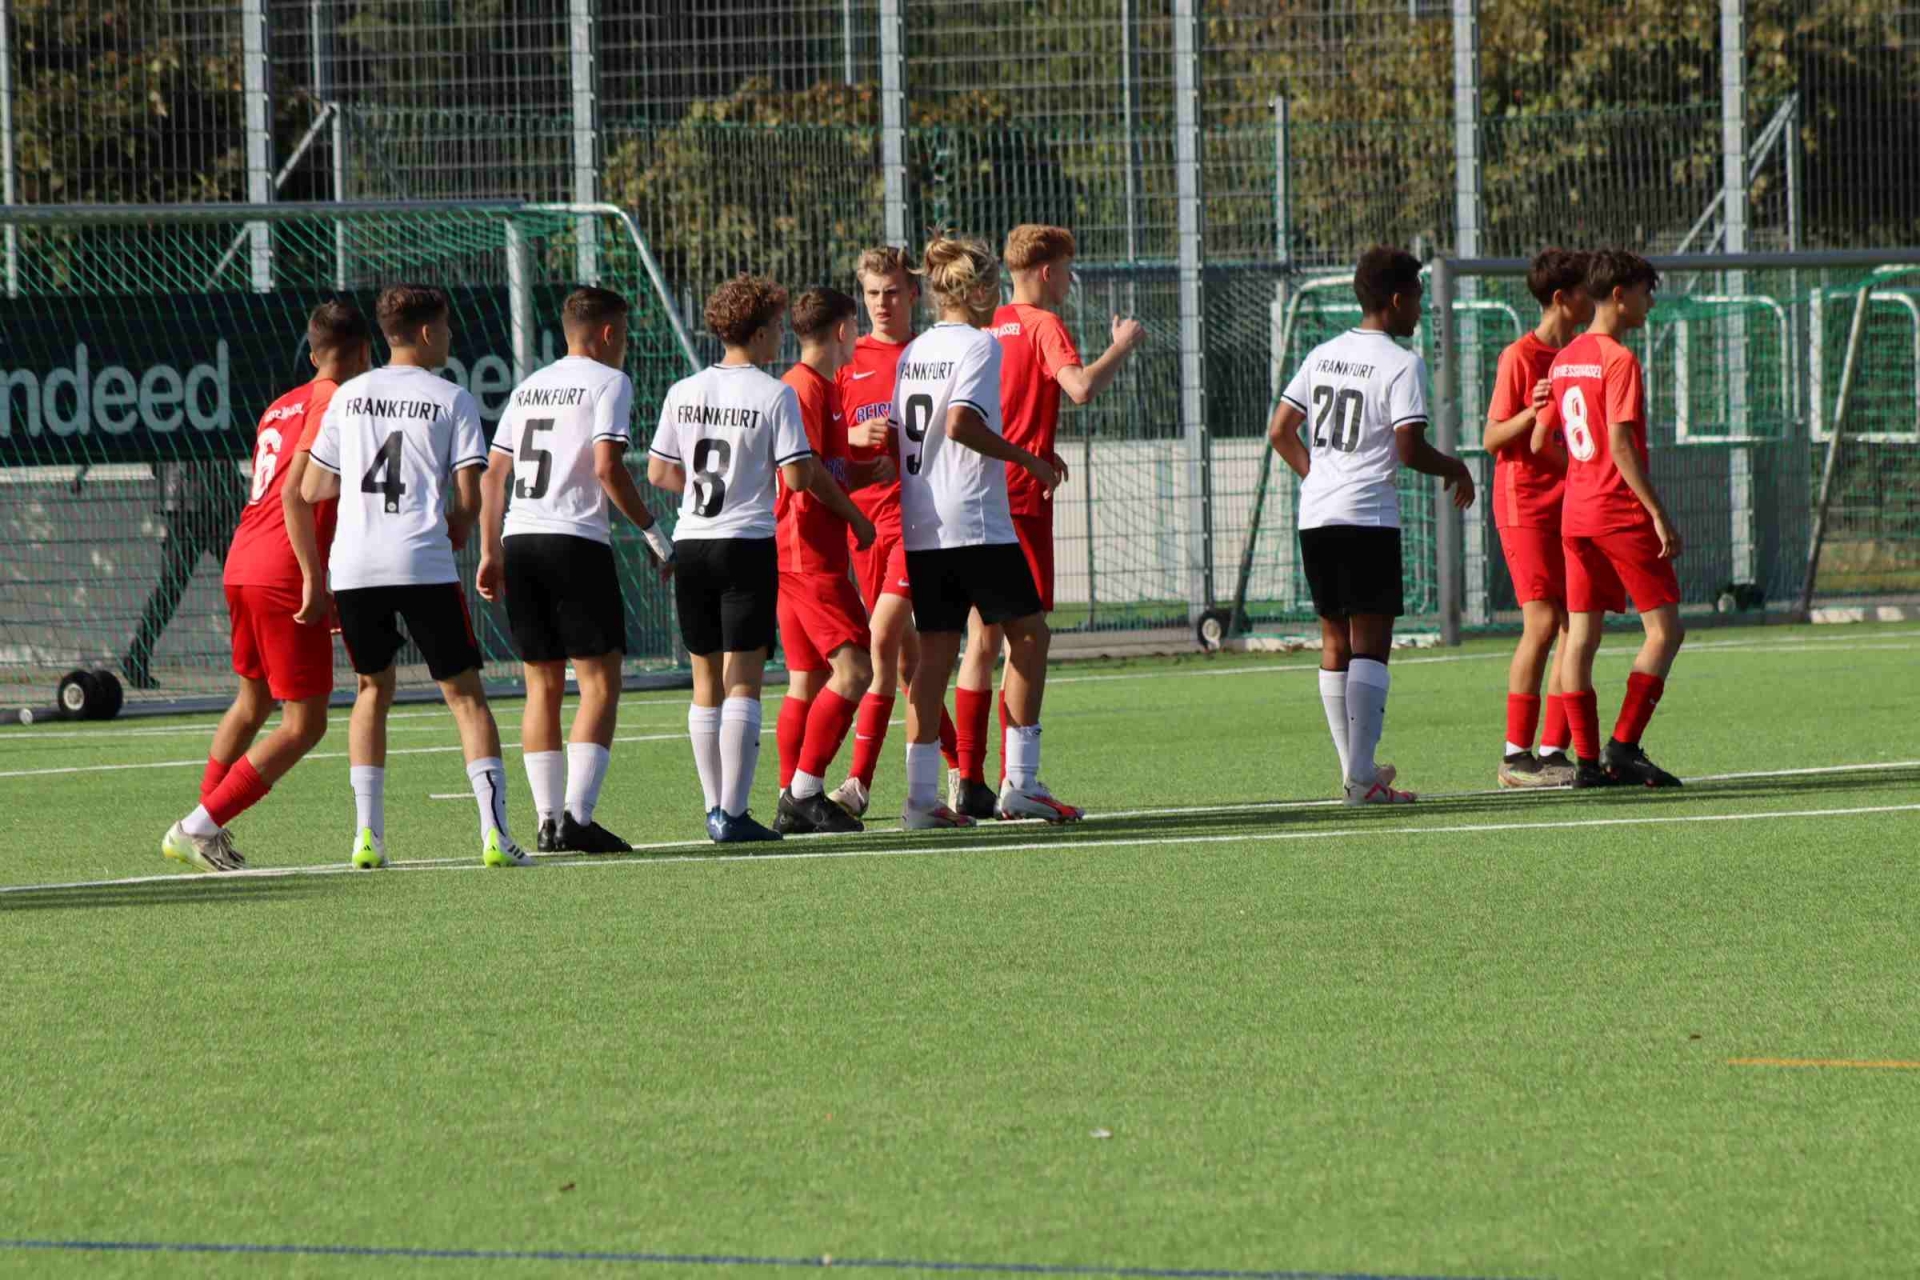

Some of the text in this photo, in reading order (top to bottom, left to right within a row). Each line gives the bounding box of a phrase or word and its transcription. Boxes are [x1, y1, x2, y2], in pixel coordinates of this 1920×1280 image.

[1315, 359, 1376, 379] FRANKFURT
[346, 397, 441, 422] FRANKFURT
[678, 405, 760, 429] FRANKFURT
[905, 393, 934, 475] 9
[1312, 384, 1364, 453] 20
[1562, 385, 1596, 462] 8
[249, 427, 283, 505] 6
[361, 430, 406, 514] 4
[515, 418, 555, 500] 5
[691, 438, 732, 518] 8
